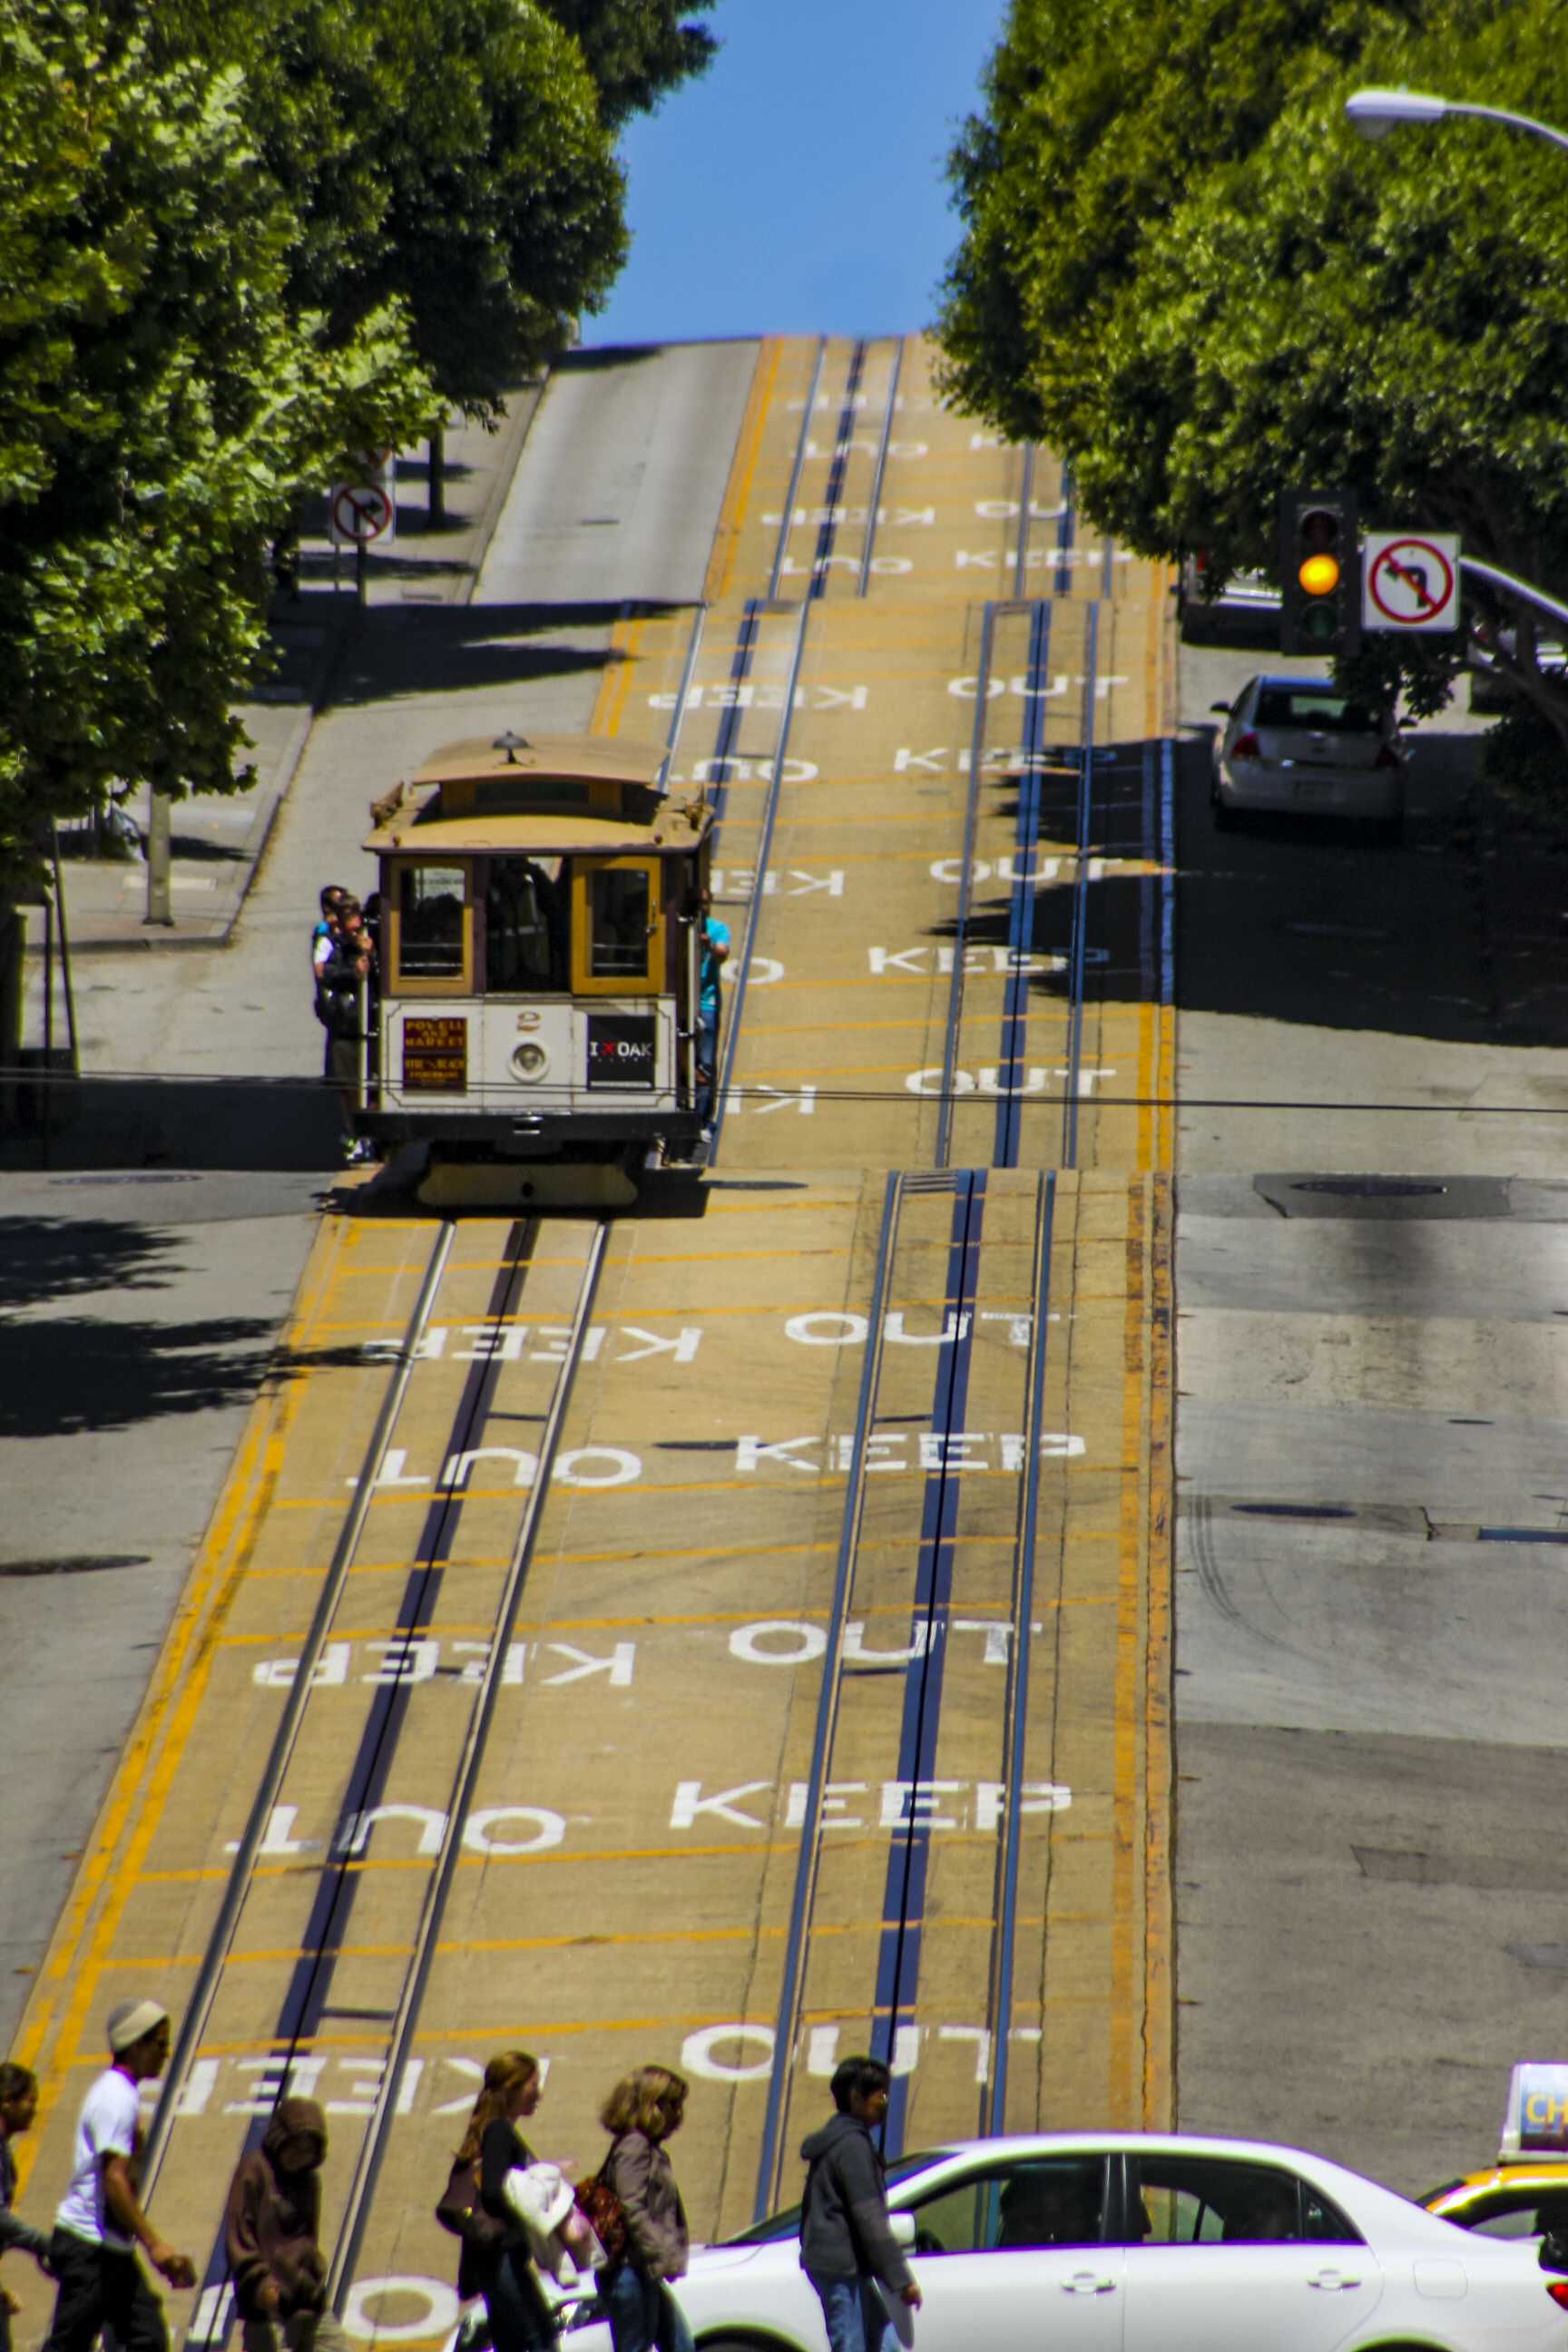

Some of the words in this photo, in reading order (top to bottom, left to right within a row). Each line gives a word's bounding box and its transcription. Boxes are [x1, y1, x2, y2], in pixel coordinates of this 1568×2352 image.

[789, 441, 929, 458] OUT
[760, 506, 936, 526] KEEP
[975, 500, 1068, 518] OU
[767, 555, 914, 575] OUT
[956, 548, 1133, 569] KEEP
[648, 685, 867, 710] KEEP
[947, 675, 1129, 700] OUT
[894, 747, 1117, 772] KEEP
[710, 869, 844, 897] KE
[929, 857, 1123, 884] OUT
[867, 946, 1110, 974] KEEP
[406, 1021, 464, 1031] POWELL
[517, 1012, 541, 1032] 2
[406, 1037, 465, 1046] MARKET
[618, 1042, 652, 1056] OAK
[906, 1068, 1117, 1097] OUT
[785, 1311, 1071, 1347] OUT
[363, 1326, 703, 1362] KEEP
[735, 1433, 1086, 1471] KEEP
[346, 1447, 642, 1487] OUT
[729, 1619, 1043, 1664] OUT
[252, 1642, 636, 1685] KEEP
[670, 1781, 1073, 1829] KEEP
[224, 1804, 566, 1854] OUT
[681, 2024, 1044, 2082] OUT
